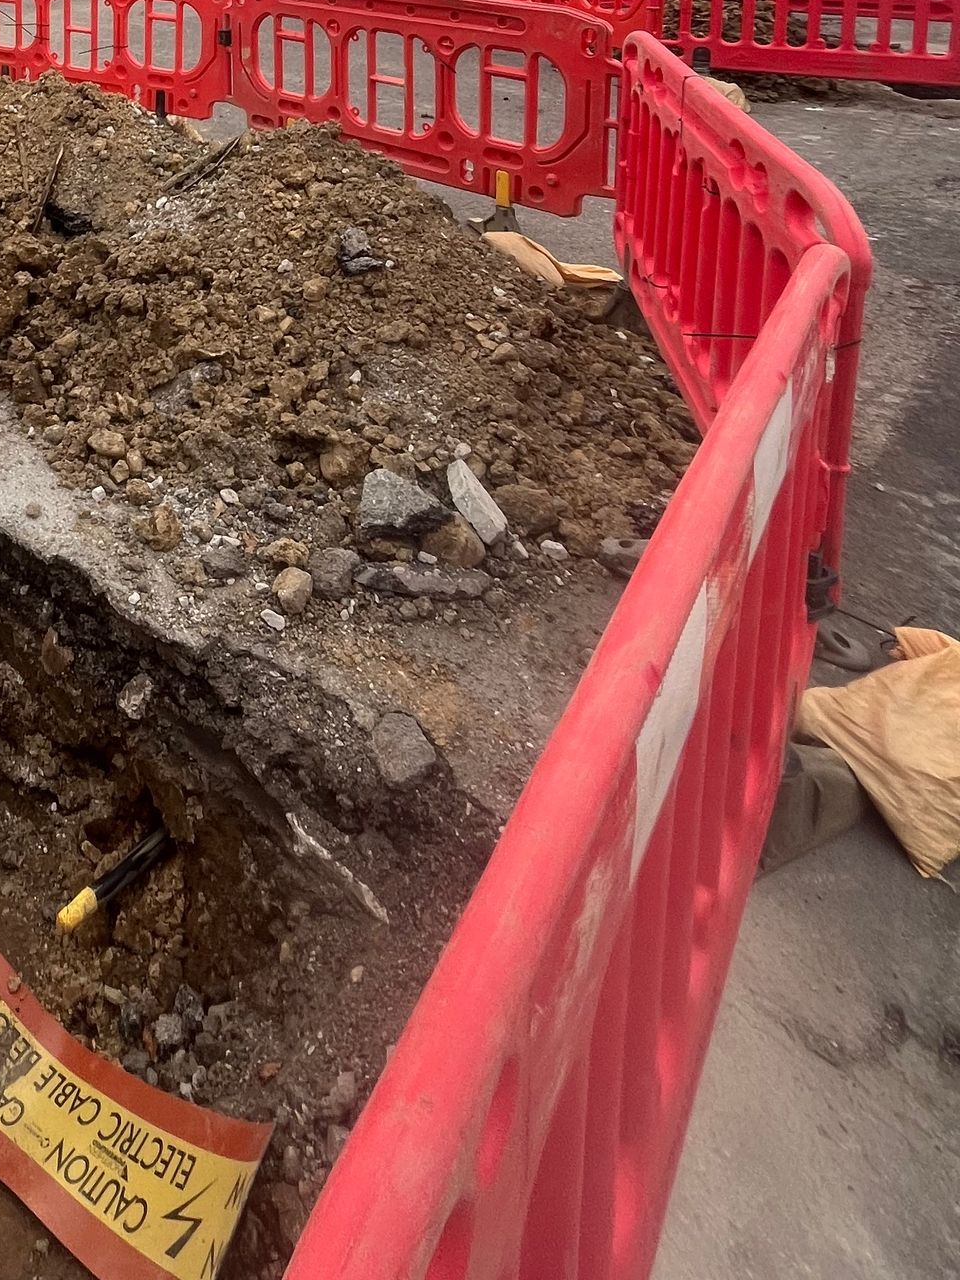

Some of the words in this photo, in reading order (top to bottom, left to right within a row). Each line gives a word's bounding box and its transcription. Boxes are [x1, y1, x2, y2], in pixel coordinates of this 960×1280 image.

[33, 1064, 102, 1126] CABLE
[45, 1137, 148, 1234] CAUTION
[97, 1111, 197, 1191] ELECTRIC
